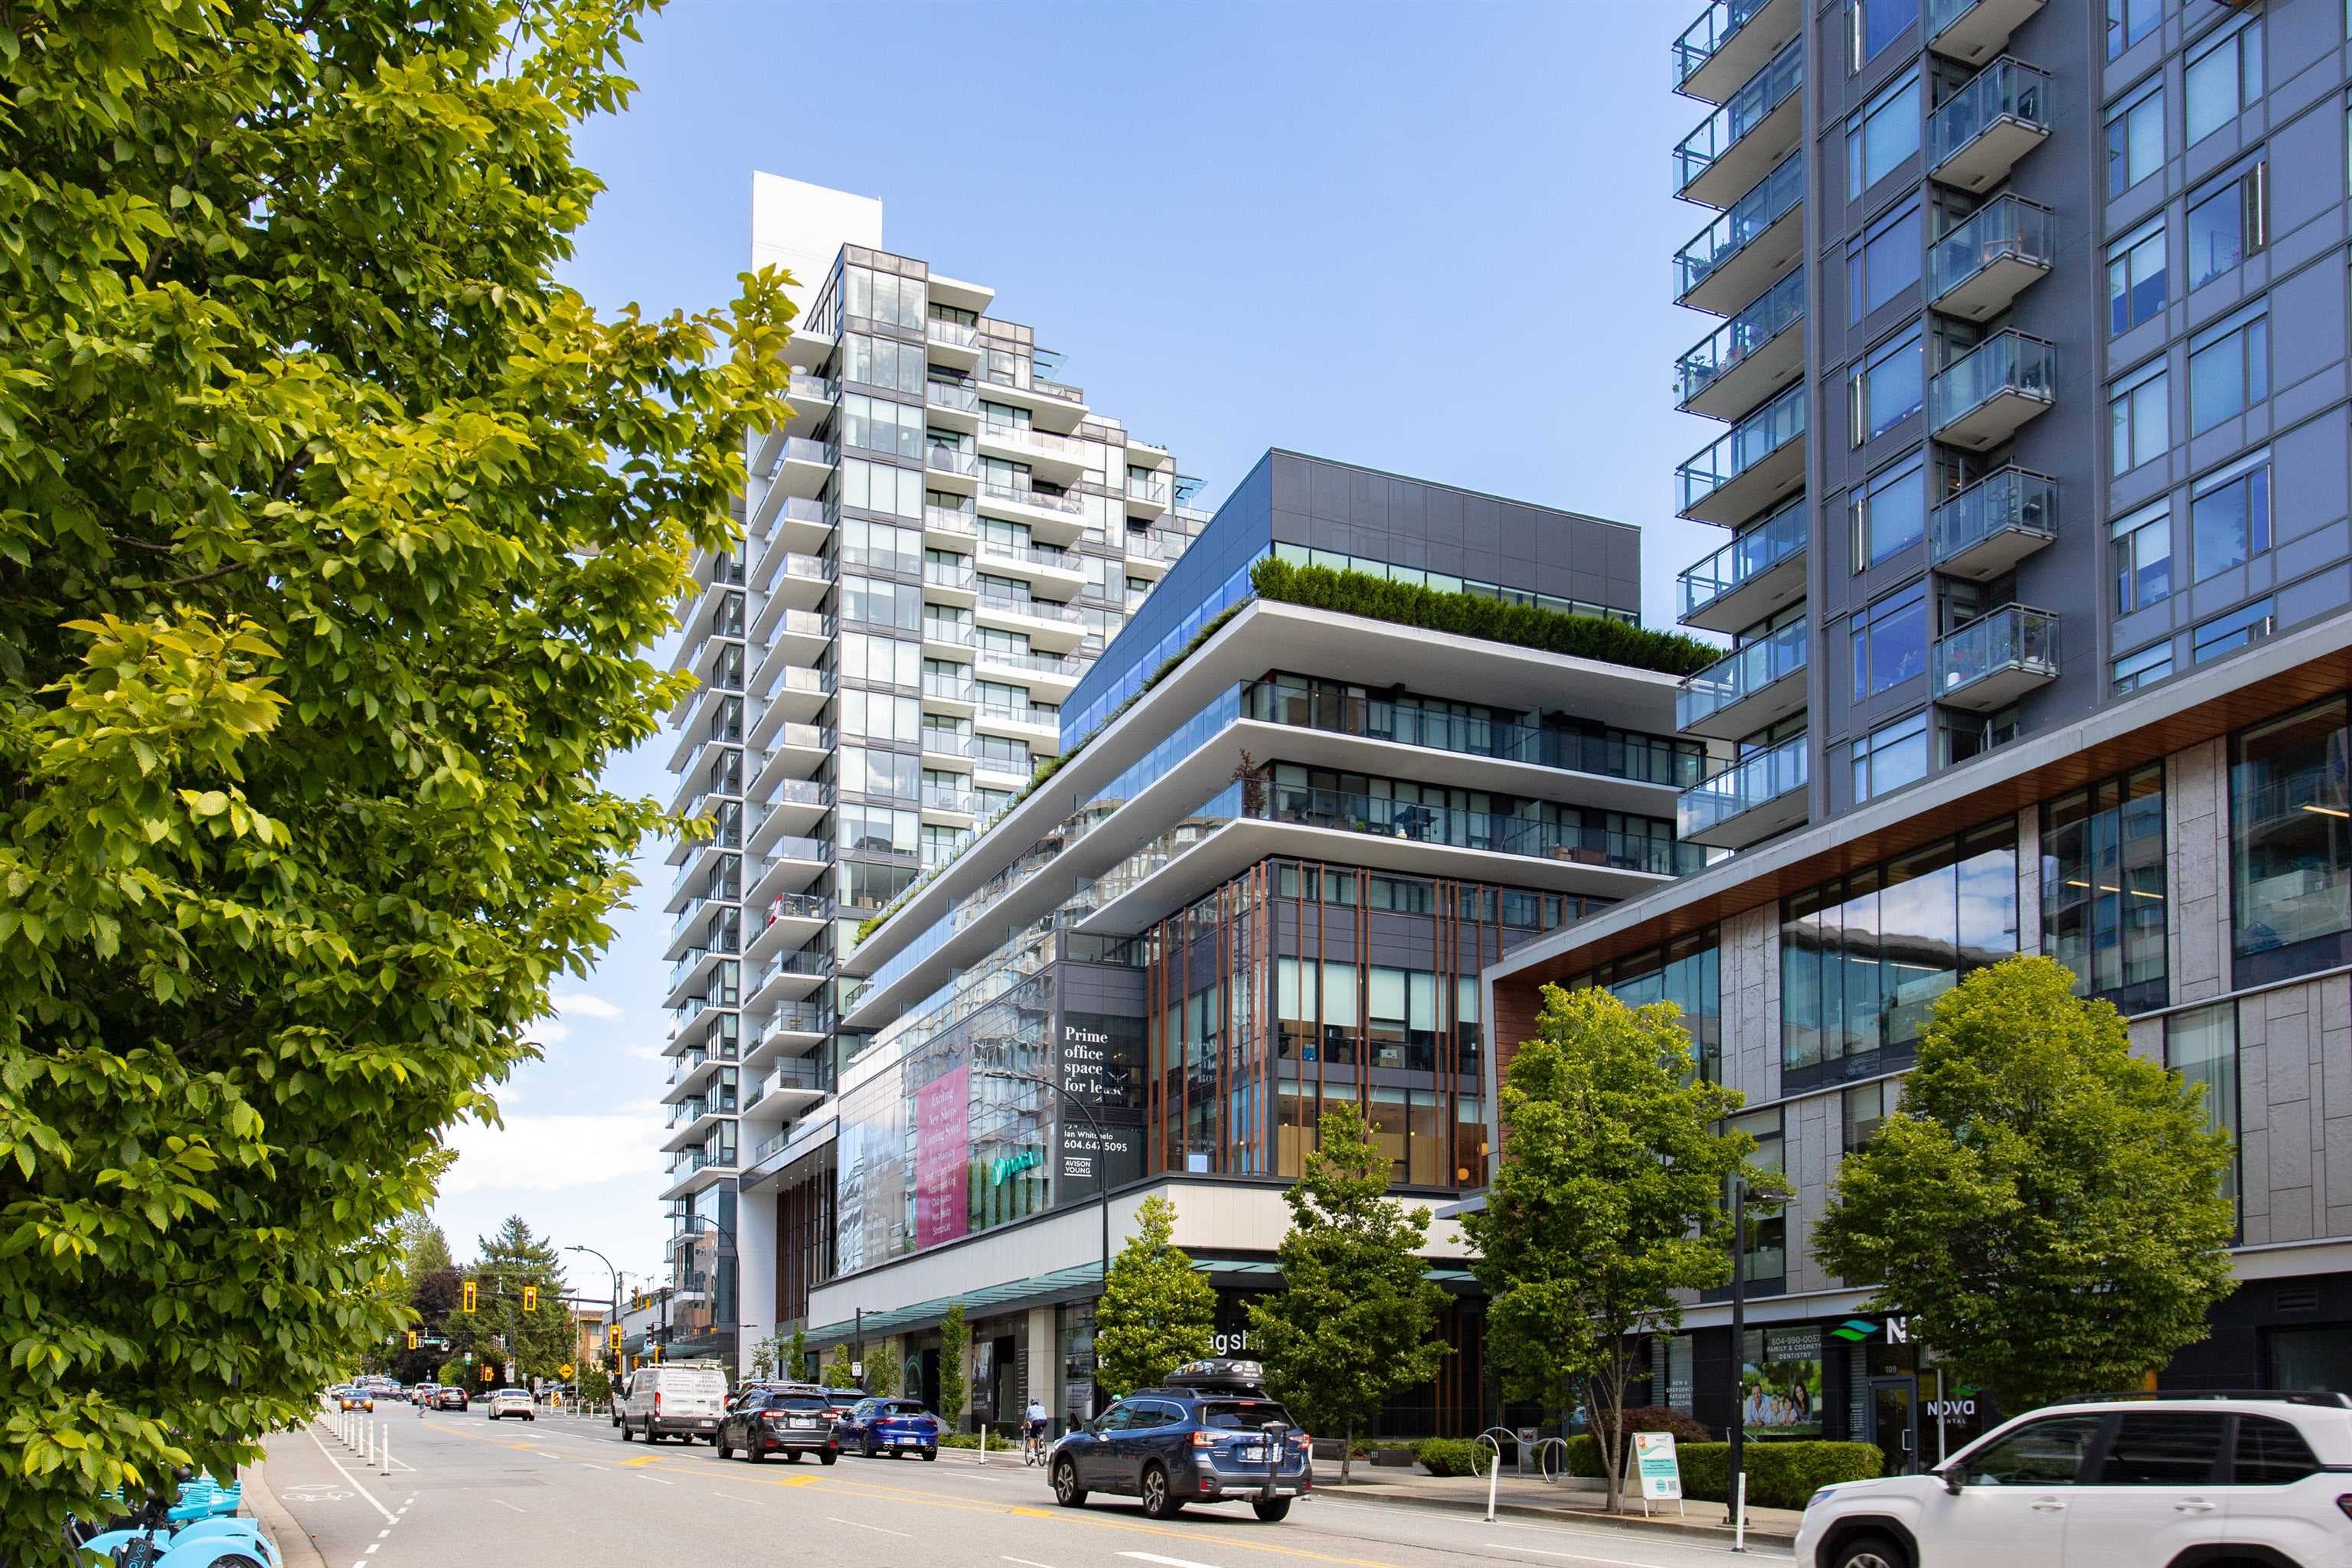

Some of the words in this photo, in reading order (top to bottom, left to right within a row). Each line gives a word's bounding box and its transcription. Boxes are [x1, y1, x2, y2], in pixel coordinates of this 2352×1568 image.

[1065, 1026, 1108, 1043] Prime
[1064, 1044, 1103, 1060] office
[1064, 1063, 1102, 1077] space
[1064, 1077, 1086, 1092] for
[1064, 1139, 1128, 1152] 604.6475095
[1772, 1334, 1820, 1345] 604-990-0057
[1779, 1351, 1812, 1360] DENTISTRY
